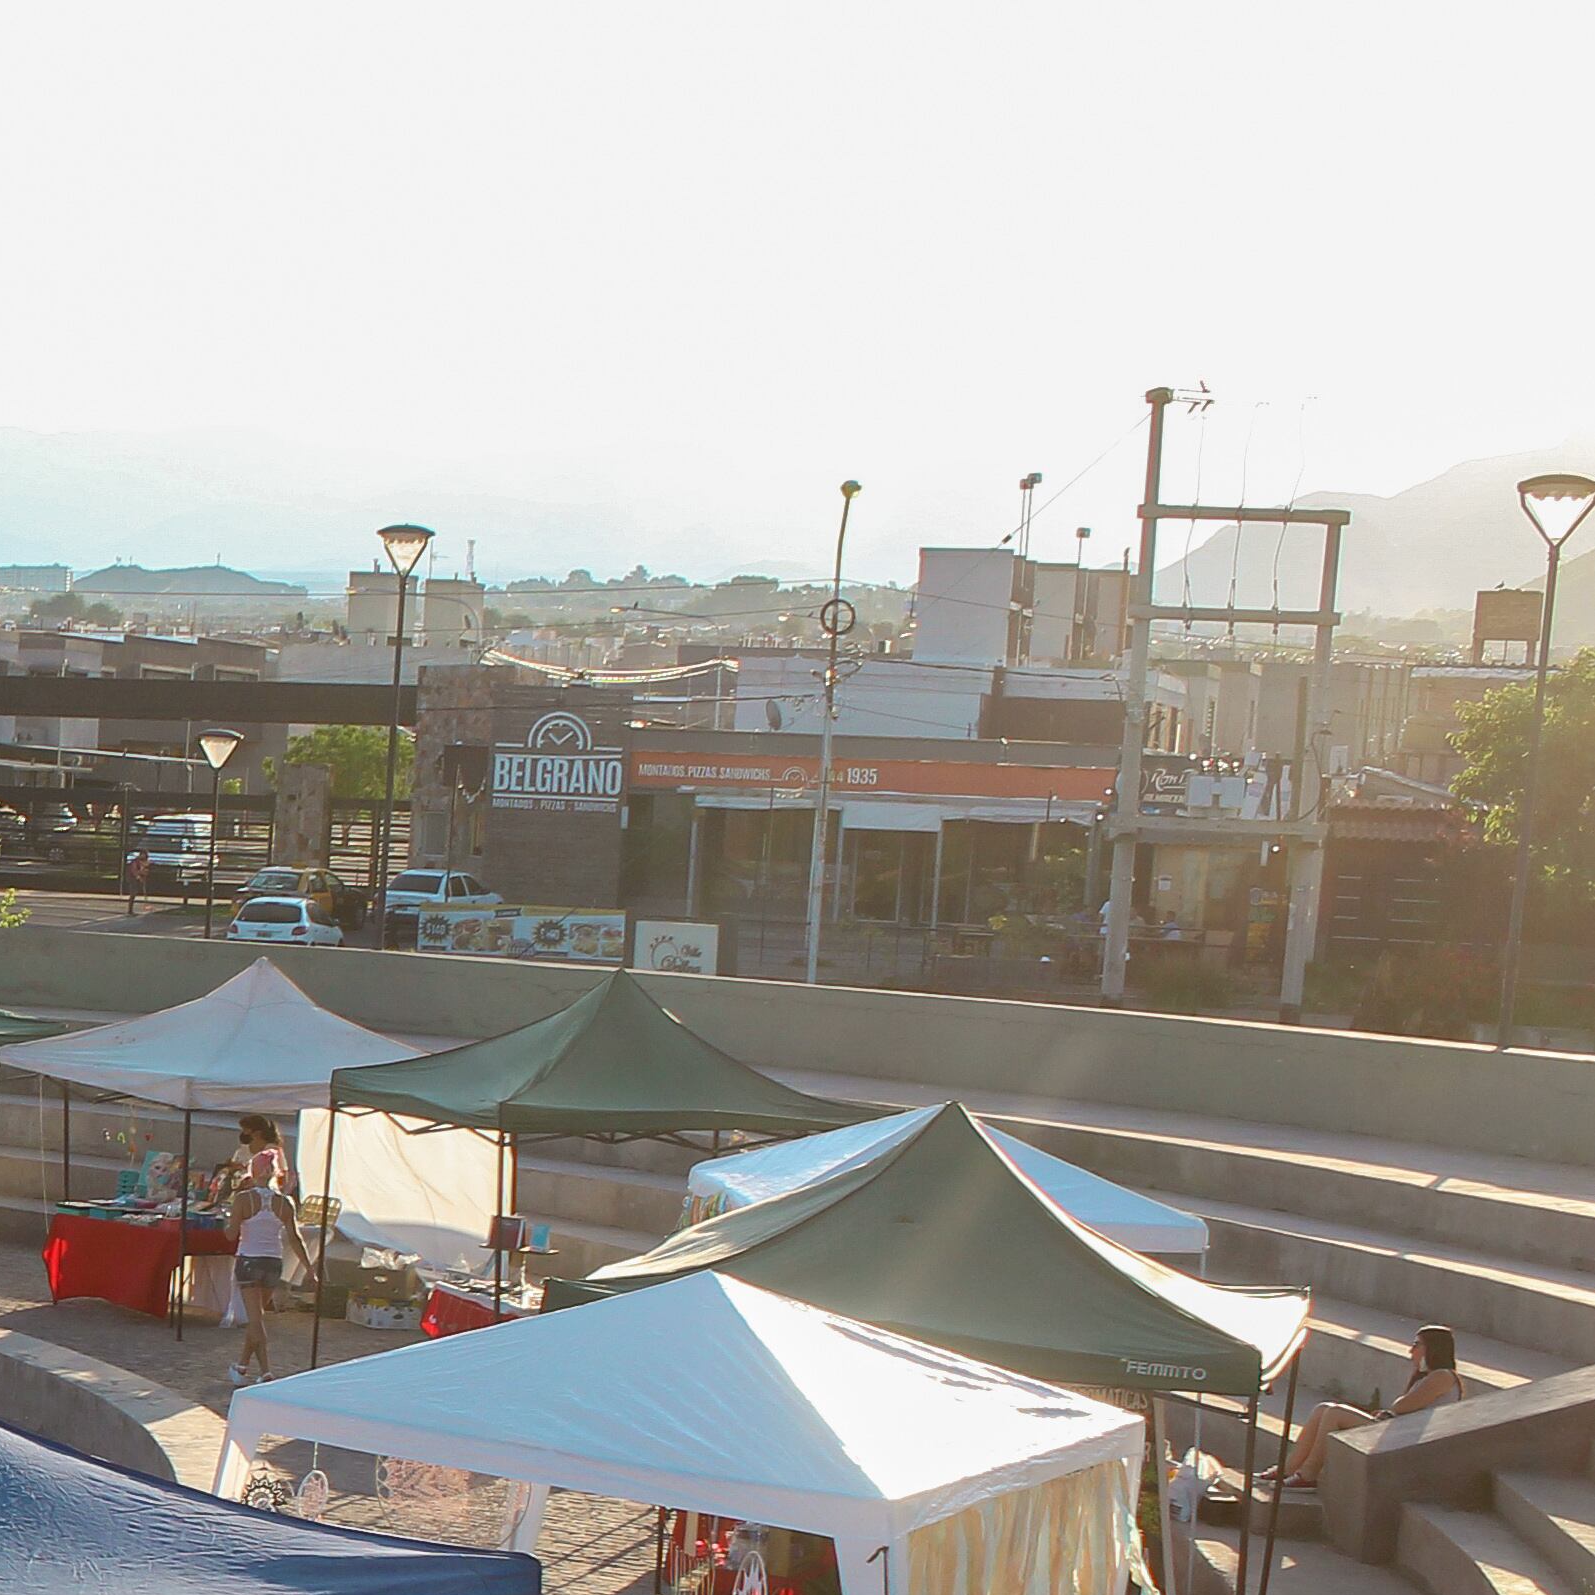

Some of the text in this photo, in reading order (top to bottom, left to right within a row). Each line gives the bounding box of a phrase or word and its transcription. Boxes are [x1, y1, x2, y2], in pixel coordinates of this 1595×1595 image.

[493, 756, 623, 796] BELGRANO
[846, 767, 878, 785] 1935
[1126, 1359, 1207, 1380] FEMMTO
